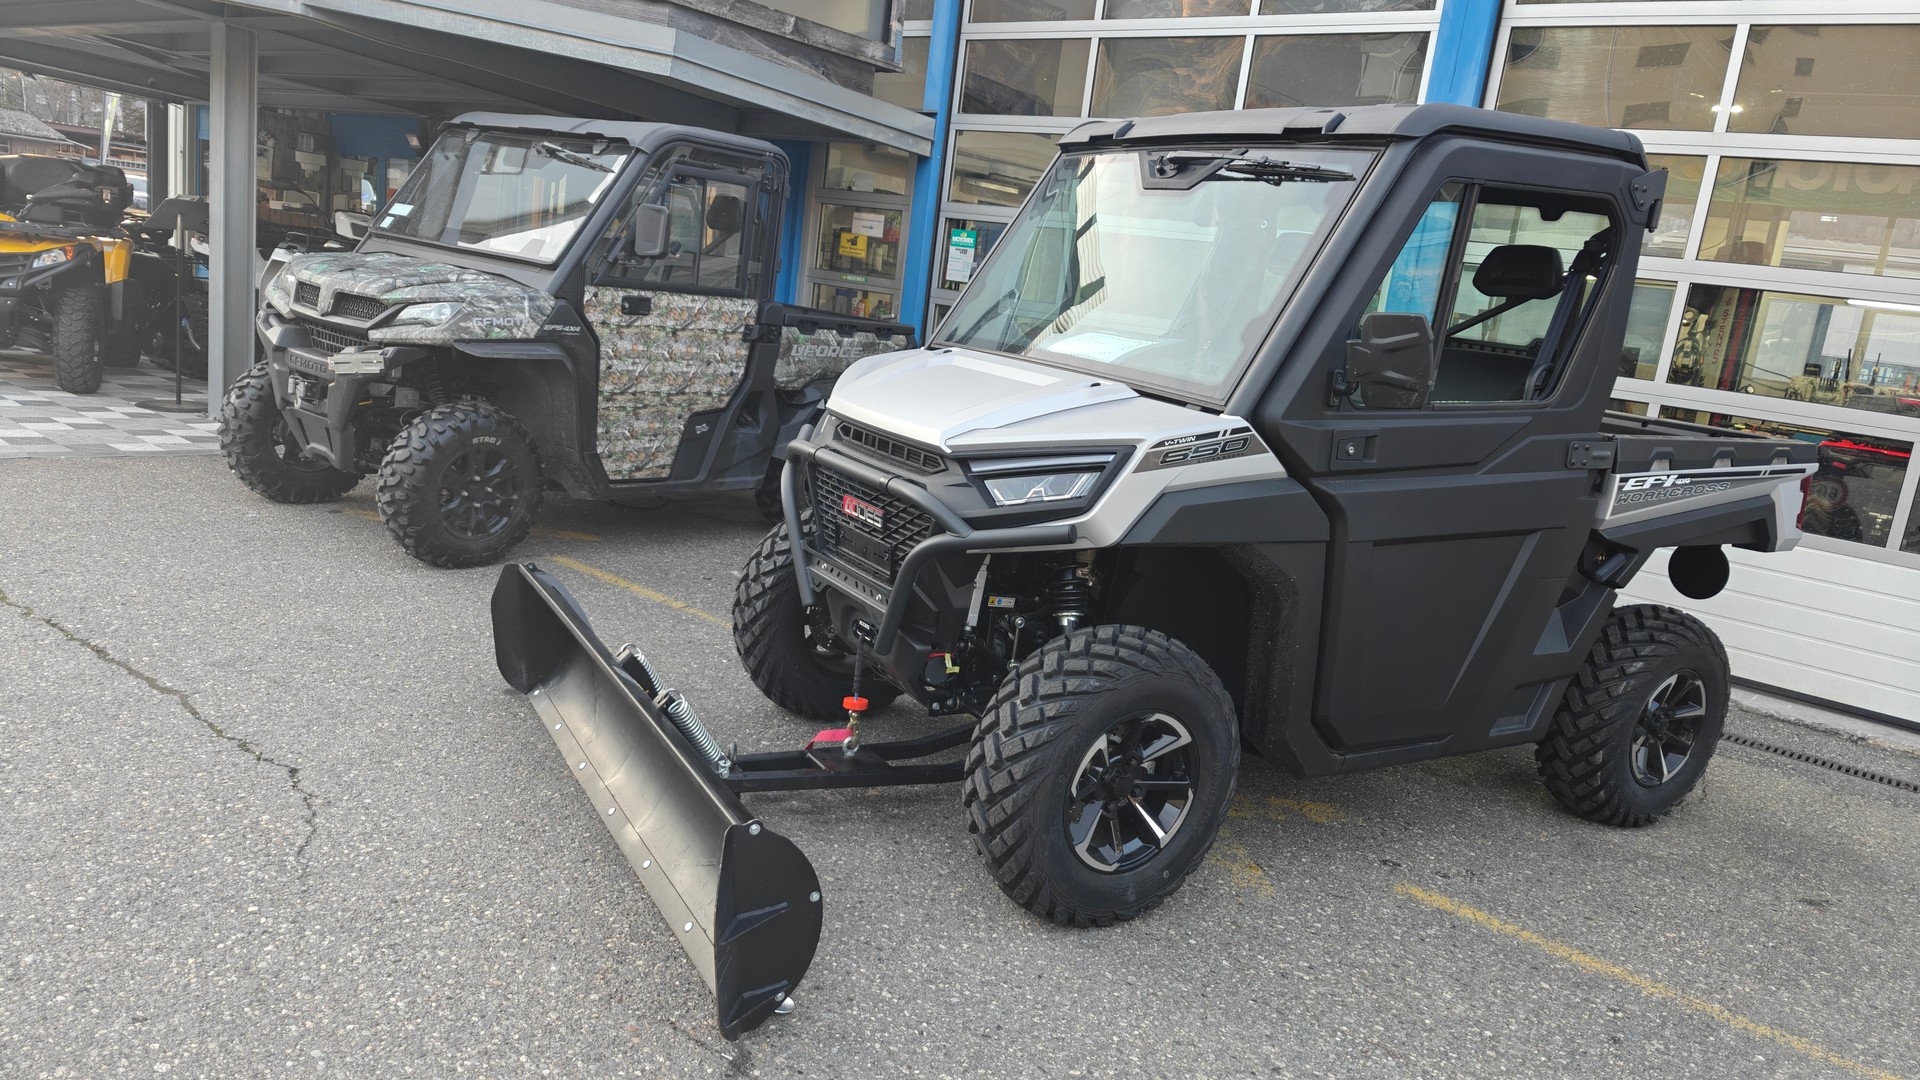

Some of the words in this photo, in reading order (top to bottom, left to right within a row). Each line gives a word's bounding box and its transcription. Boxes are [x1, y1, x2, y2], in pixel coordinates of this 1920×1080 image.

[1164, 436, 1196, 446] V-TWIN
[1159, 436, 1250, 465] 650
[1622, 474, 1678, 491] EFI
